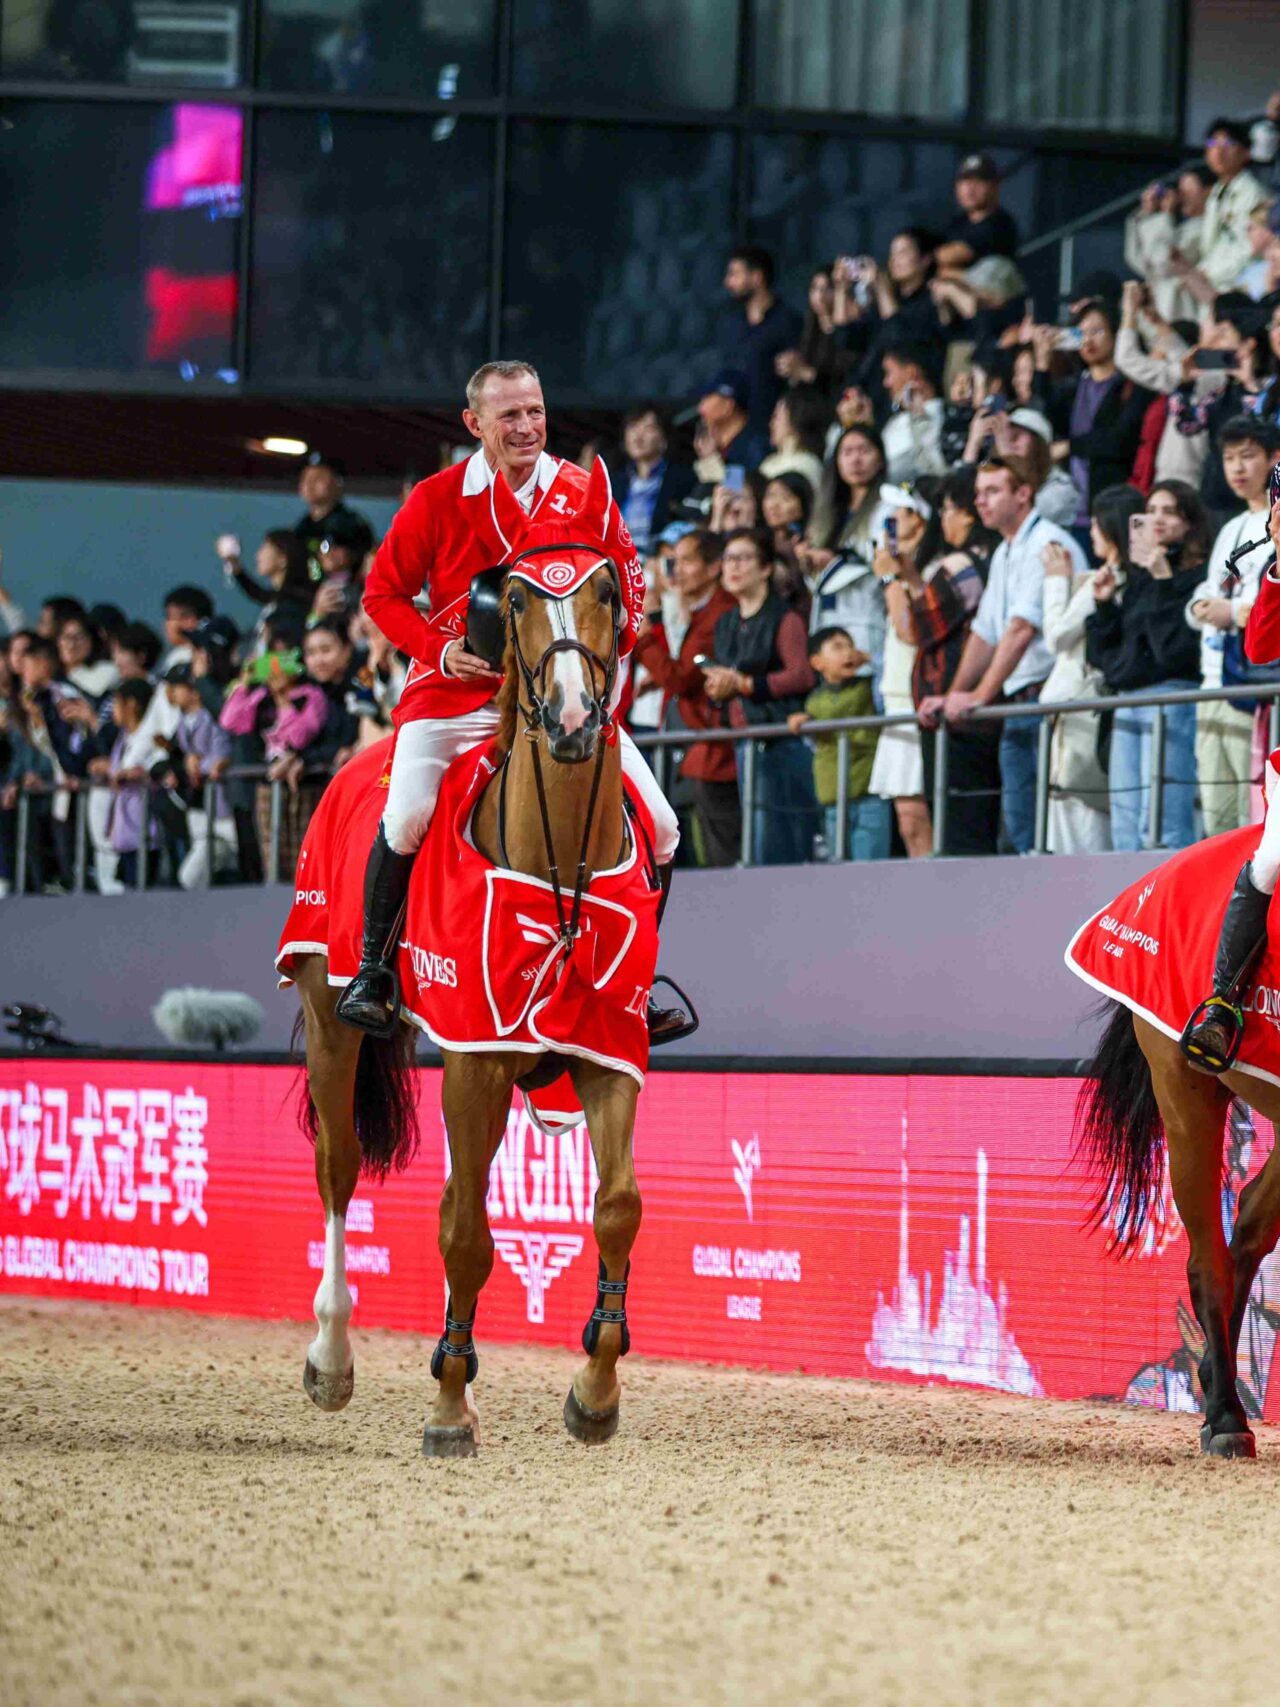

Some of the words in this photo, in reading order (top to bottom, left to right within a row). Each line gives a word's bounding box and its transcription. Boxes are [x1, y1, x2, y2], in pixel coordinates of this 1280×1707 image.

[549, 494, 577, 517] 1ST
[4, 1235, 62, 1280] GLOBAL
[64, 1239, 160, 1291] CHAMPIONS
[161, 1249, 209, 1296] TOUR
